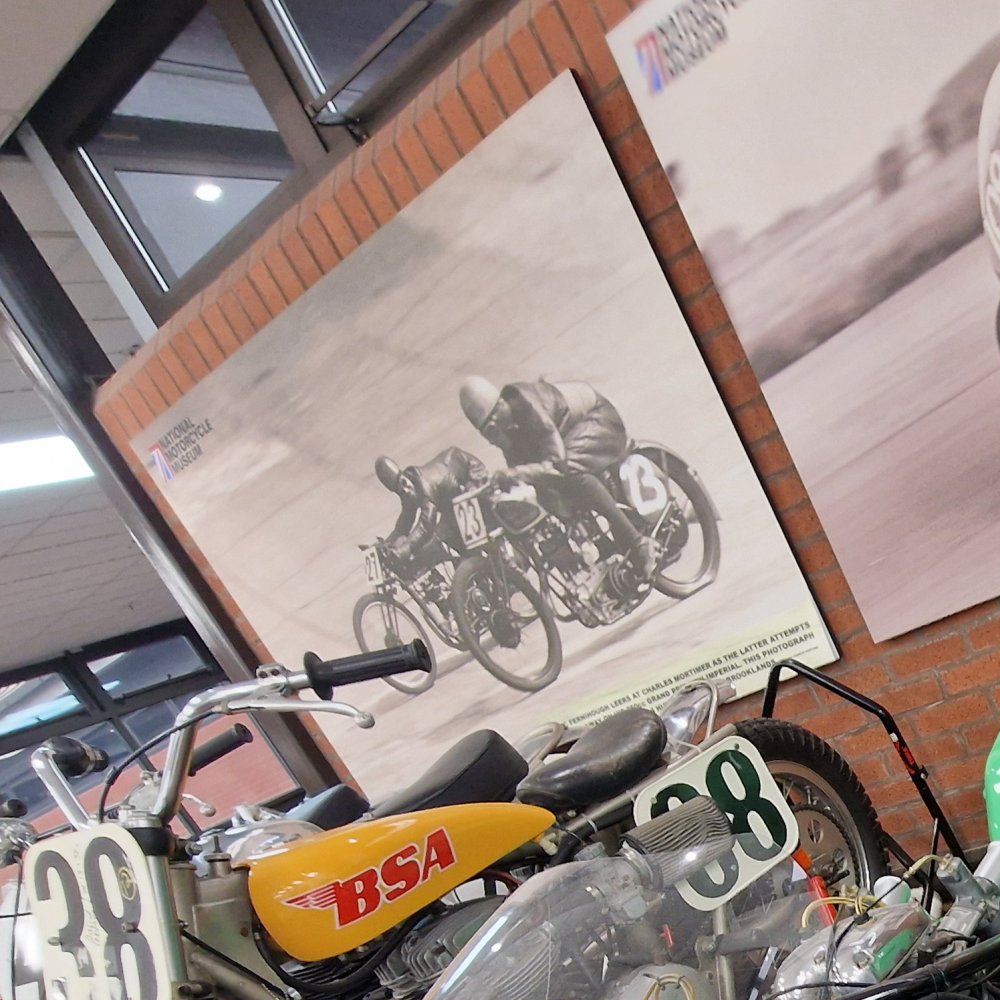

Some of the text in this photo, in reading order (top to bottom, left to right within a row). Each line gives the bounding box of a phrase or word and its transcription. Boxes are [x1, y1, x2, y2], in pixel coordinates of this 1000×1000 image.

[158, 417, 196, 448] NATIONAL
[164, 418, 213, 460] MOTORCYCLE
[171, 444, 203, 473] MUSEUM
[610, 696, 632, 710] LEERS
[632, 690, 640, 699] AT
[642, 678, 673, 696] CHARLES
[674, 661, 711, 682] MORTIMER
[712, 656, 723, 666] AS
[723, 649, 739, 660] THE
[739, 638, 769, 654] LATTER
[770, 621, 811, 642] ATTEMPTS
[646, 690, 671, 704] GRAND
[743, 653, 762, 665] THIS
[762, 632, 815, 658] PHOTOGRAPH
[334, 826, 457, 929] BSA
